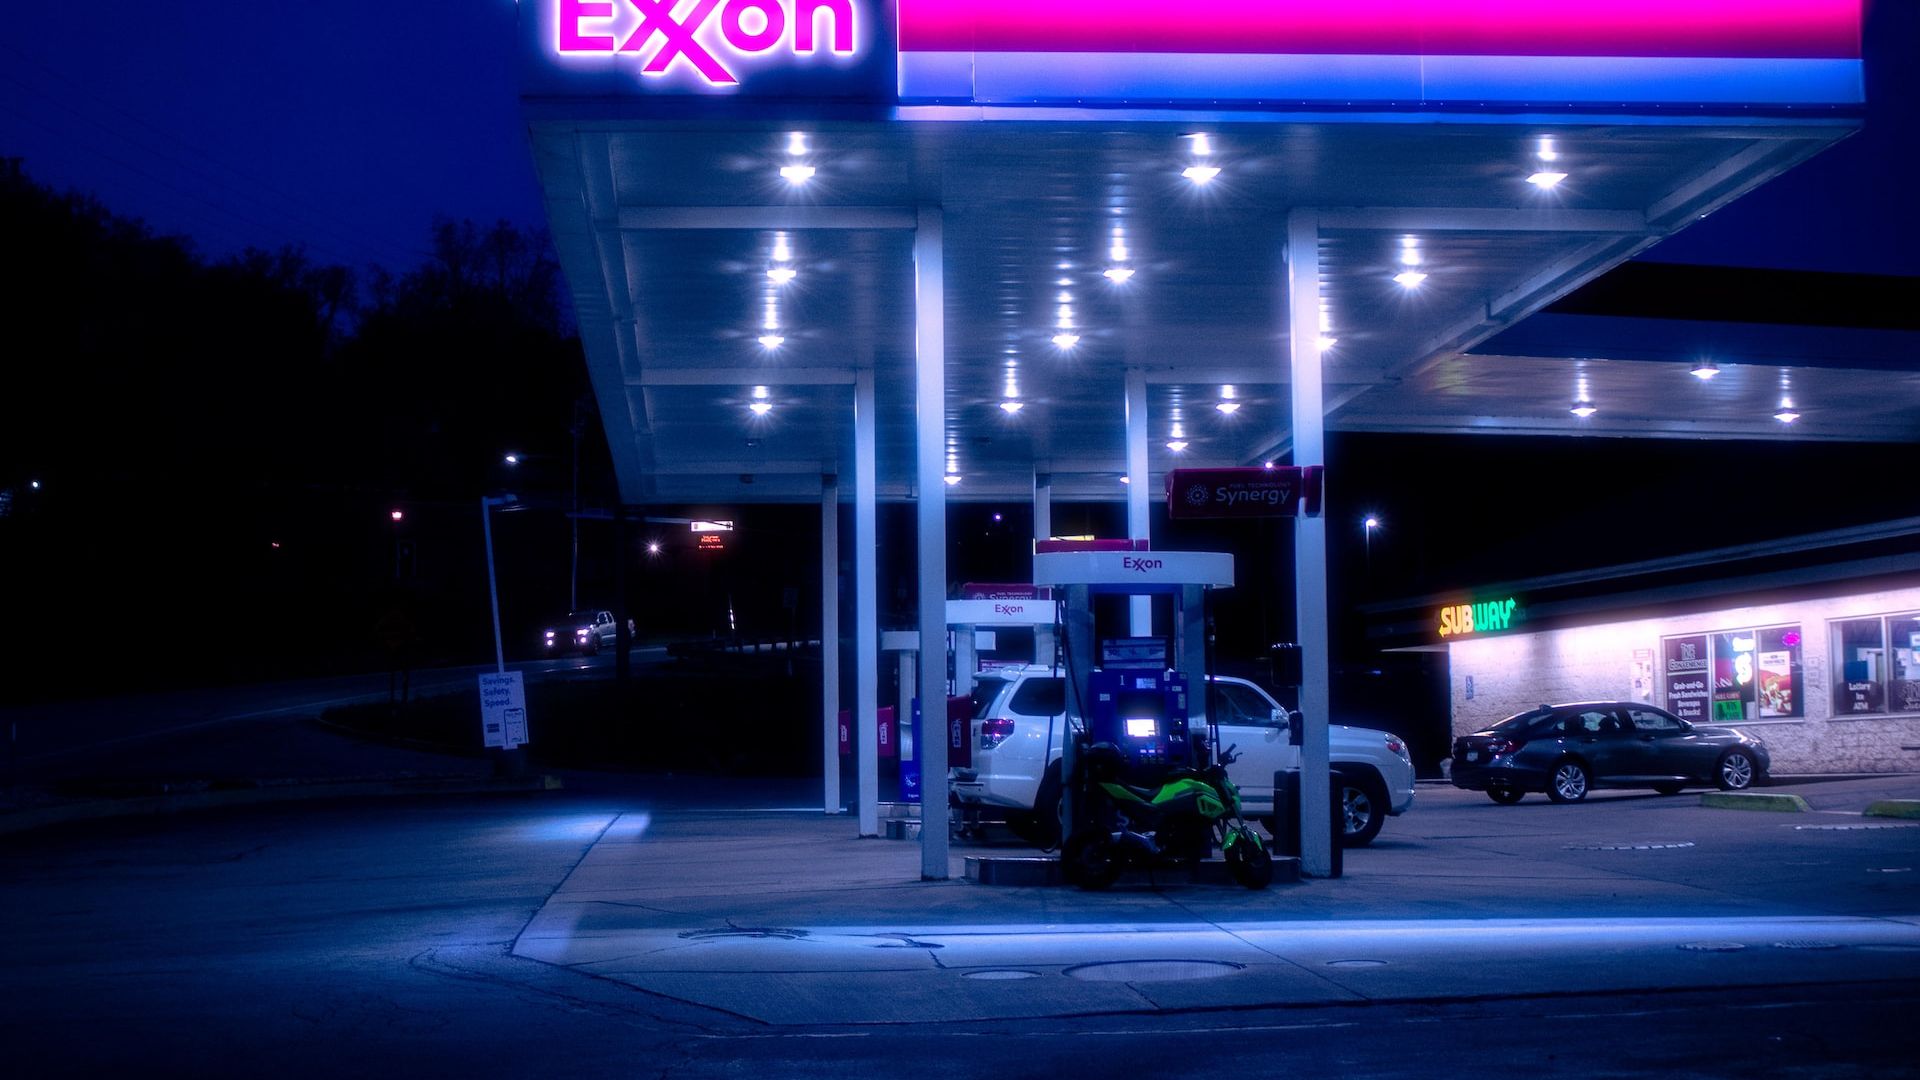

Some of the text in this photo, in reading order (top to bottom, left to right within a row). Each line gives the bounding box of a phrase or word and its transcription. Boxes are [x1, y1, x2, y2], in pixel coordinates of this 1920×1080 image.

[558, 0, 854, 84] Exxon
[1216, 487, 1291, 506] Synergy
[1123, 557, 1162, 573] Exxon
[995, 604, 1023, 616] Exxon
[1439, 597, 1516, 637] SUBWAY
